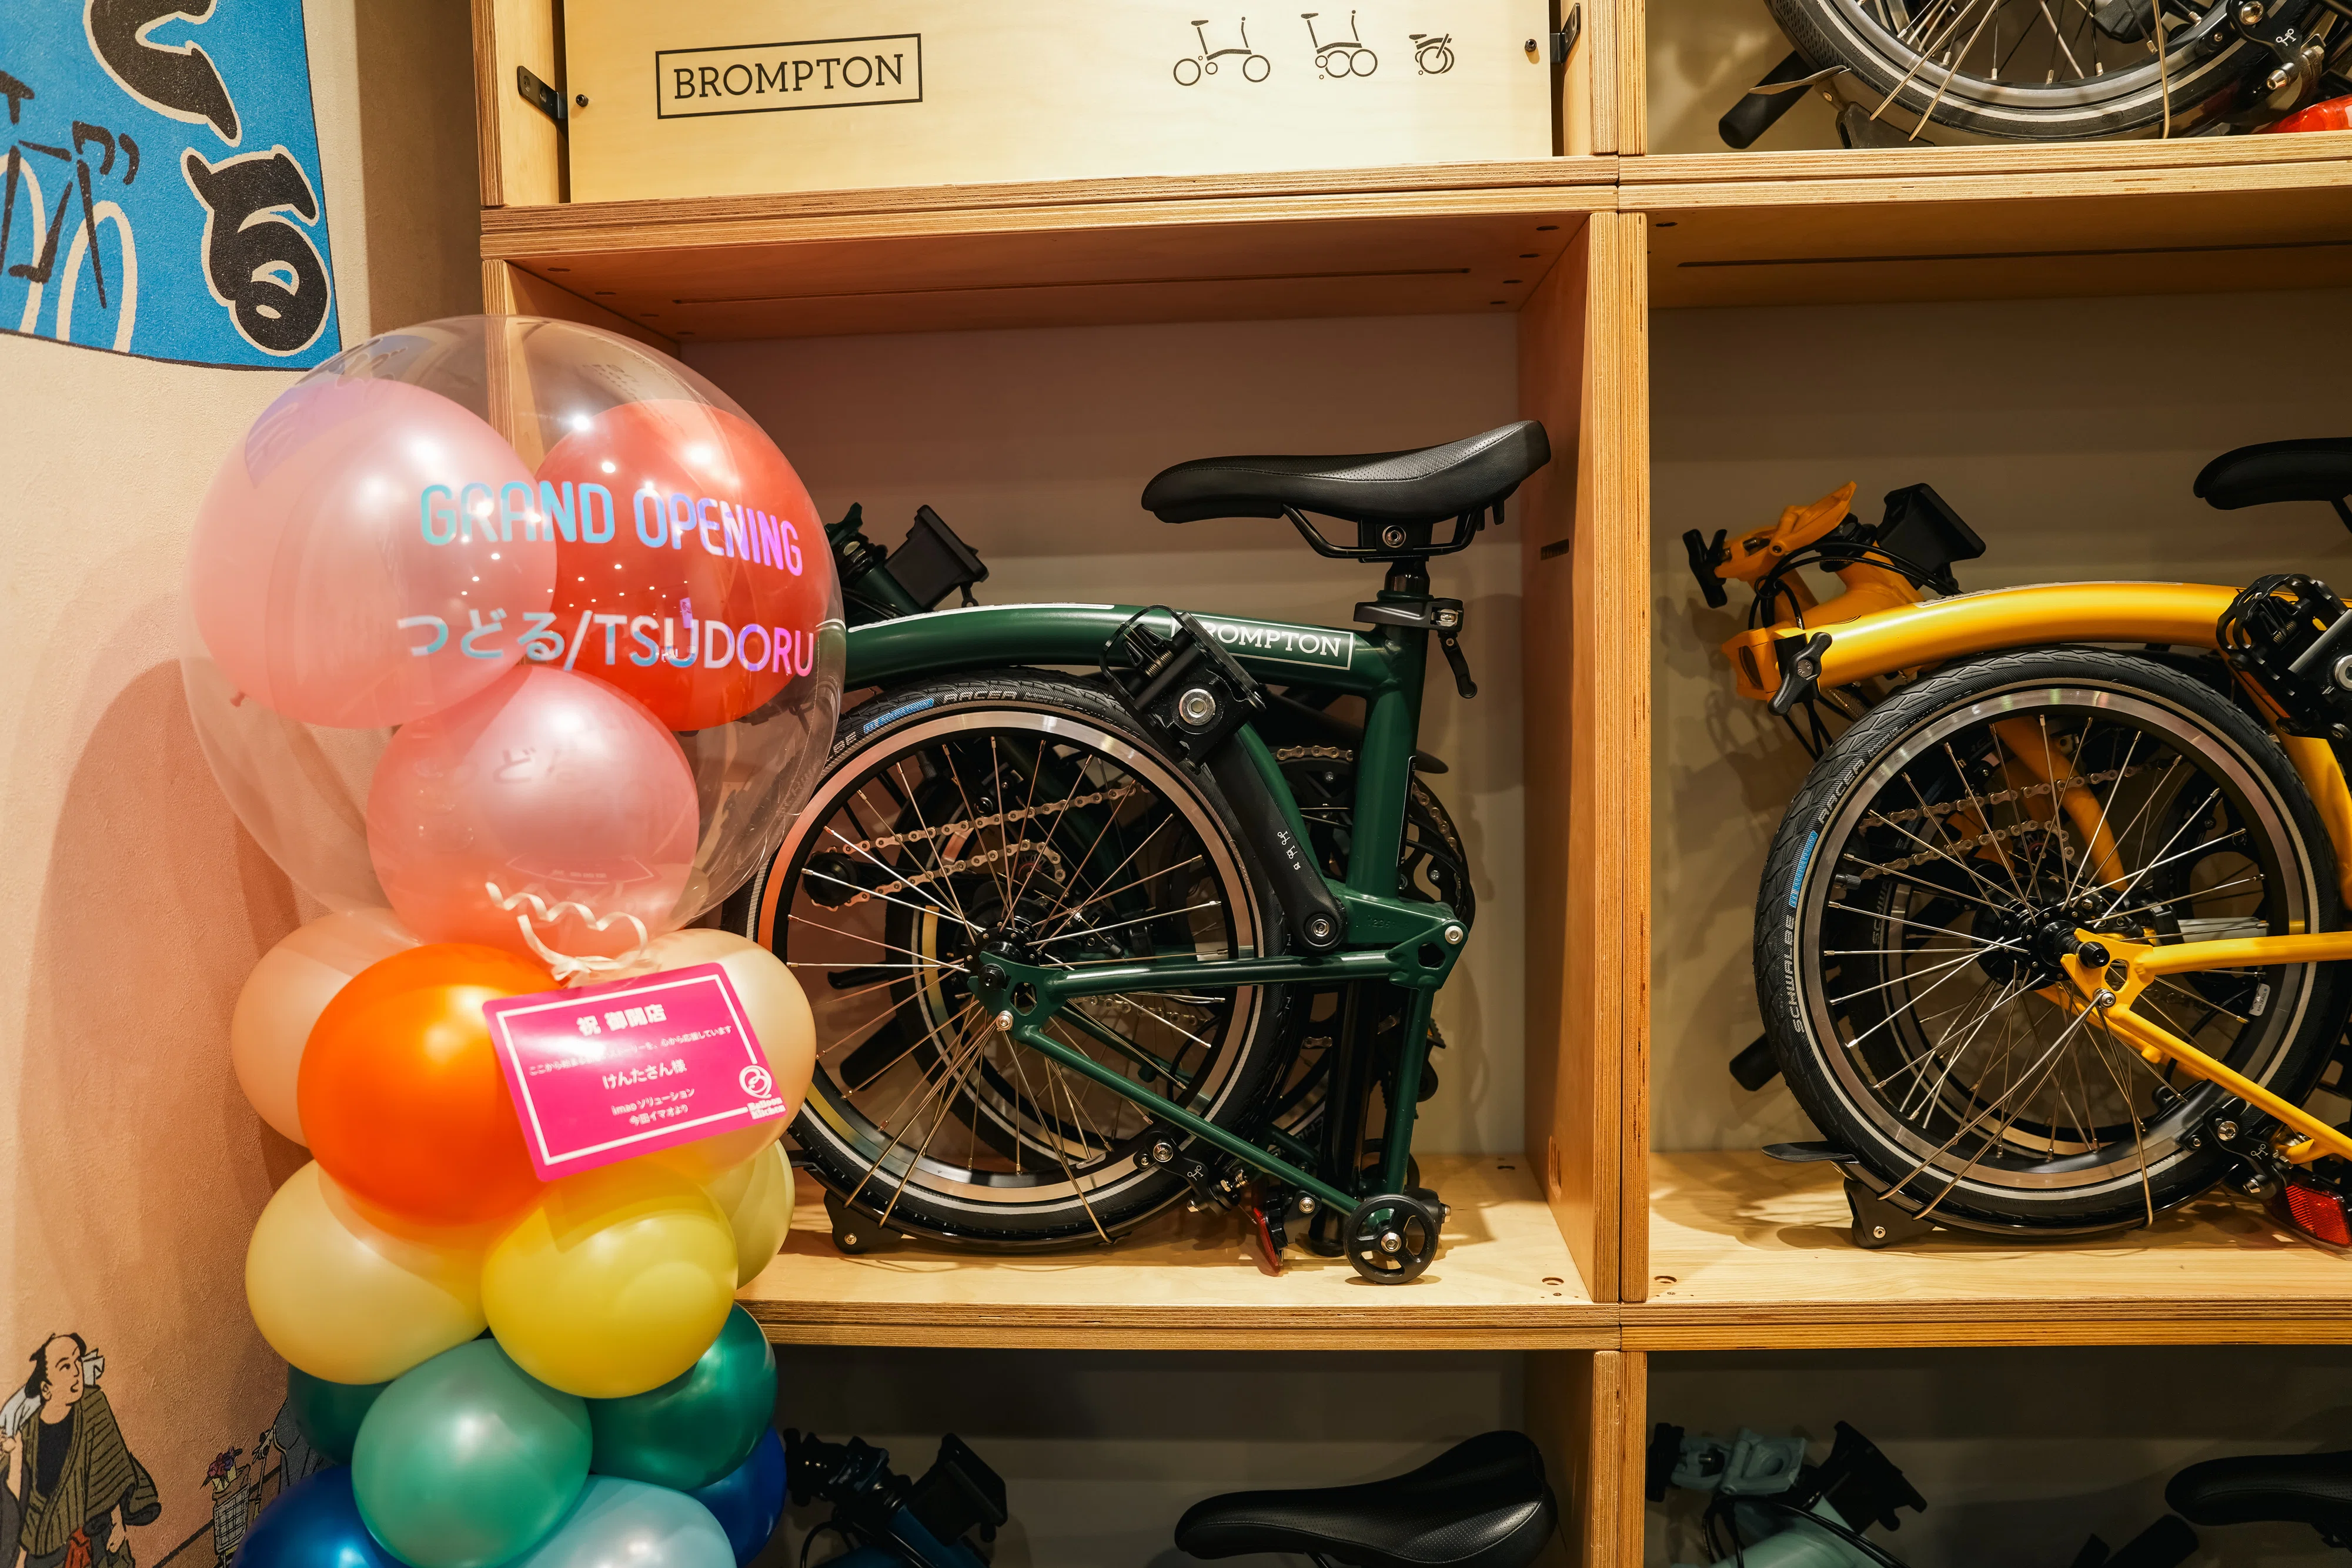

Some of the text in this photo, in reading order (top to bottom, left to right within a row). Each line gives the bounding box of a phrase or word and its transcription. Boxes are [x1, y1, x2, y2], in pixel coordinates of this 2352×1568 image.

[673, 54, 904, 99] BROMPTON
[420, 480, 803, 576] GRAND OPENING
[397, 608, 814, 677] つどる/TSUDORU
[1201, 621, 1341, 657] ROMPTON
[943, 690, 1017, 704] RACER
[1818, 758, 1866, 825] RACER
[1784, 914, 1805, 1033] SCHWALBE
[576, 1004, 667, 1037] 祝 御開店
[602, 1059, 687, 1089] けんたさん様
